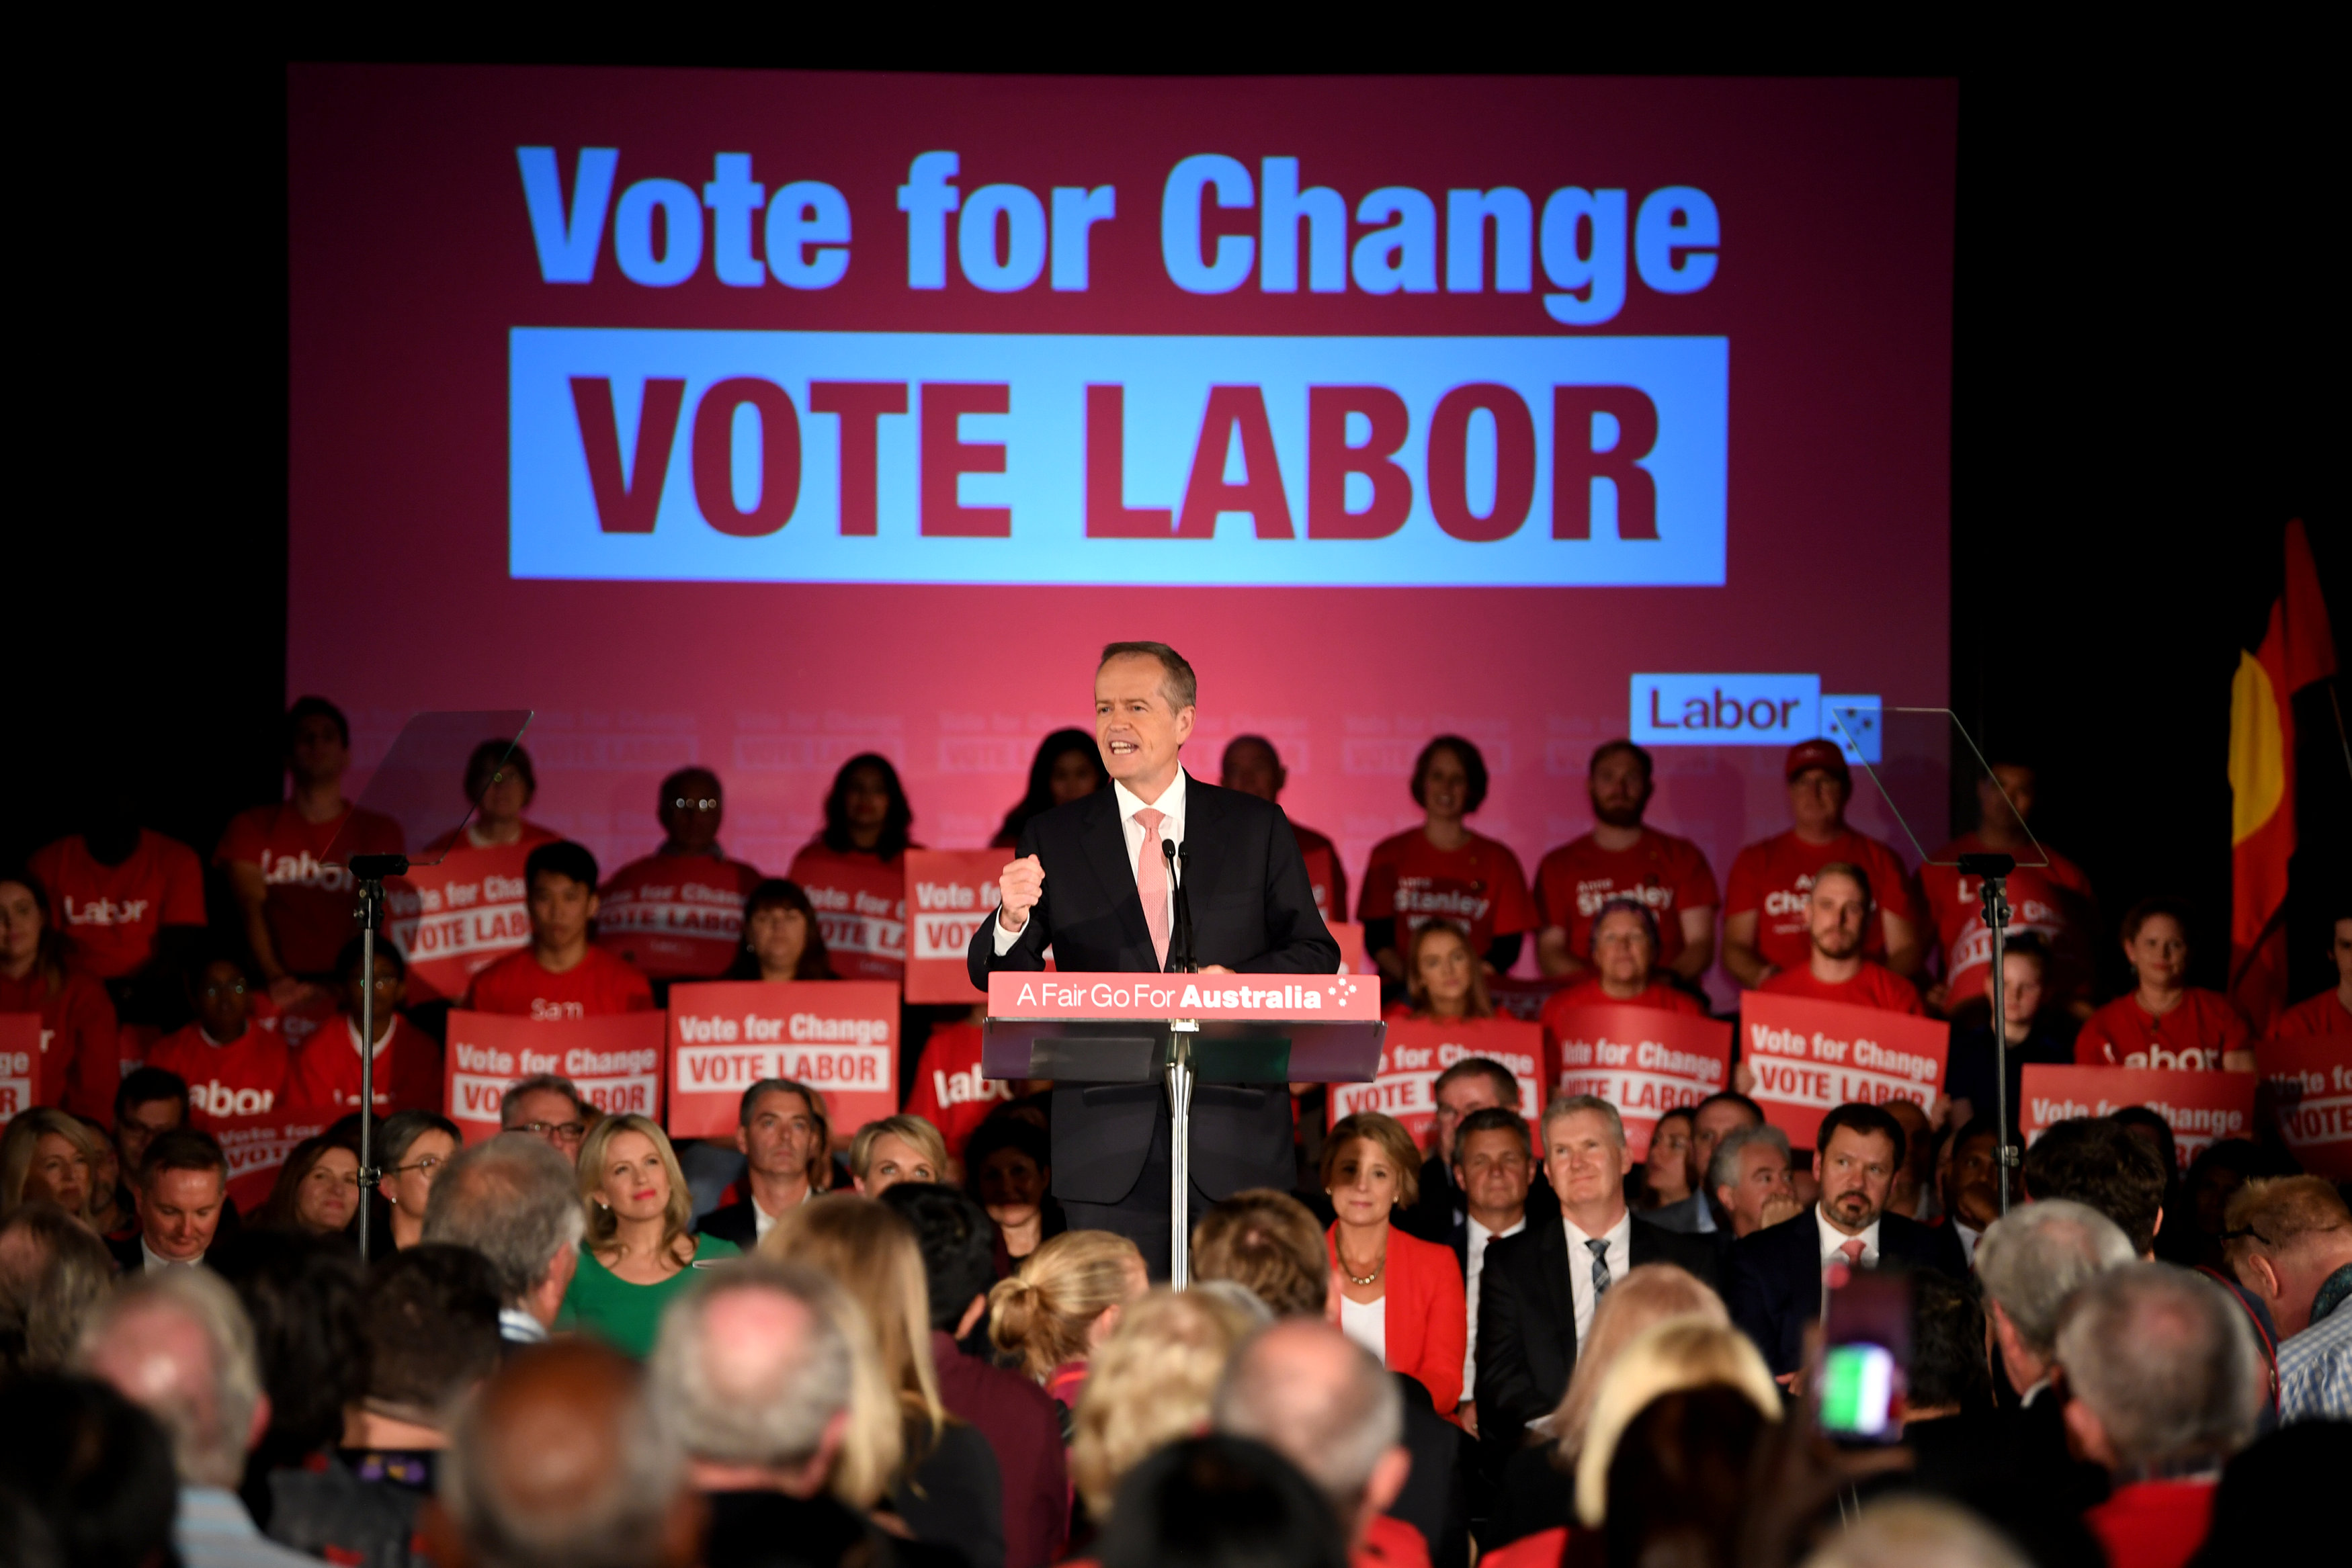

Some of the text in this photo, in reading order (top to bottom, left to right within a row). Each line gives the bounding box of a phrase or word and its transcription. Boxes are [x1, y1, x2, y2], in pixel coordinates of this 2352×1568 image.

[515, 146, 1722, 326] Vote for Change
[569, 376, 1662, 543] VOTE LABOR
[1650, 687, 1801, 730] Labor
[445, 881, 480, 906] for
[483, 875, 526, 903] Cha
[854, 889, 891, 916] for
[915, 881, 1001, 907] Vote fo
[65, 895, 149, 926] Labor
[667, 909, 741, 932] LABO
[401, 910, 527, 953] VOTE LAB
[816, 919, 868, 947] OTE
[926, 922, 982, 950] VOT
[530, 997, 584, 1022] Sam
[1016, 983, 1322, 1009] A Fair Go For Australia
[678, 1012, 888, 1047] Vote for Change
[455, 1043, 658, 1076] Vote for Change
[689, 1053, 878, 1083] VOTE LABOR
[1393, 1044, 1433, 1070] for
[1595, 1037, 1632, 1067] for
[1636, 1040, 1722, 1082] Change
[1750, 1023, 1938, 1082] Vote for Change
[933, 1062, 1015, 1110] Lab
[1760, 1063, 1831, 1102] VOTE
[2333, 1064, 2352, 1092] fo
[189, 1079, 274, 1118] abor
[463, 1082, 645, 1113] VO BOR
[1346, 1082, 1417, 1113] VOTE
[227, 1145, 292, 1170] VOT
